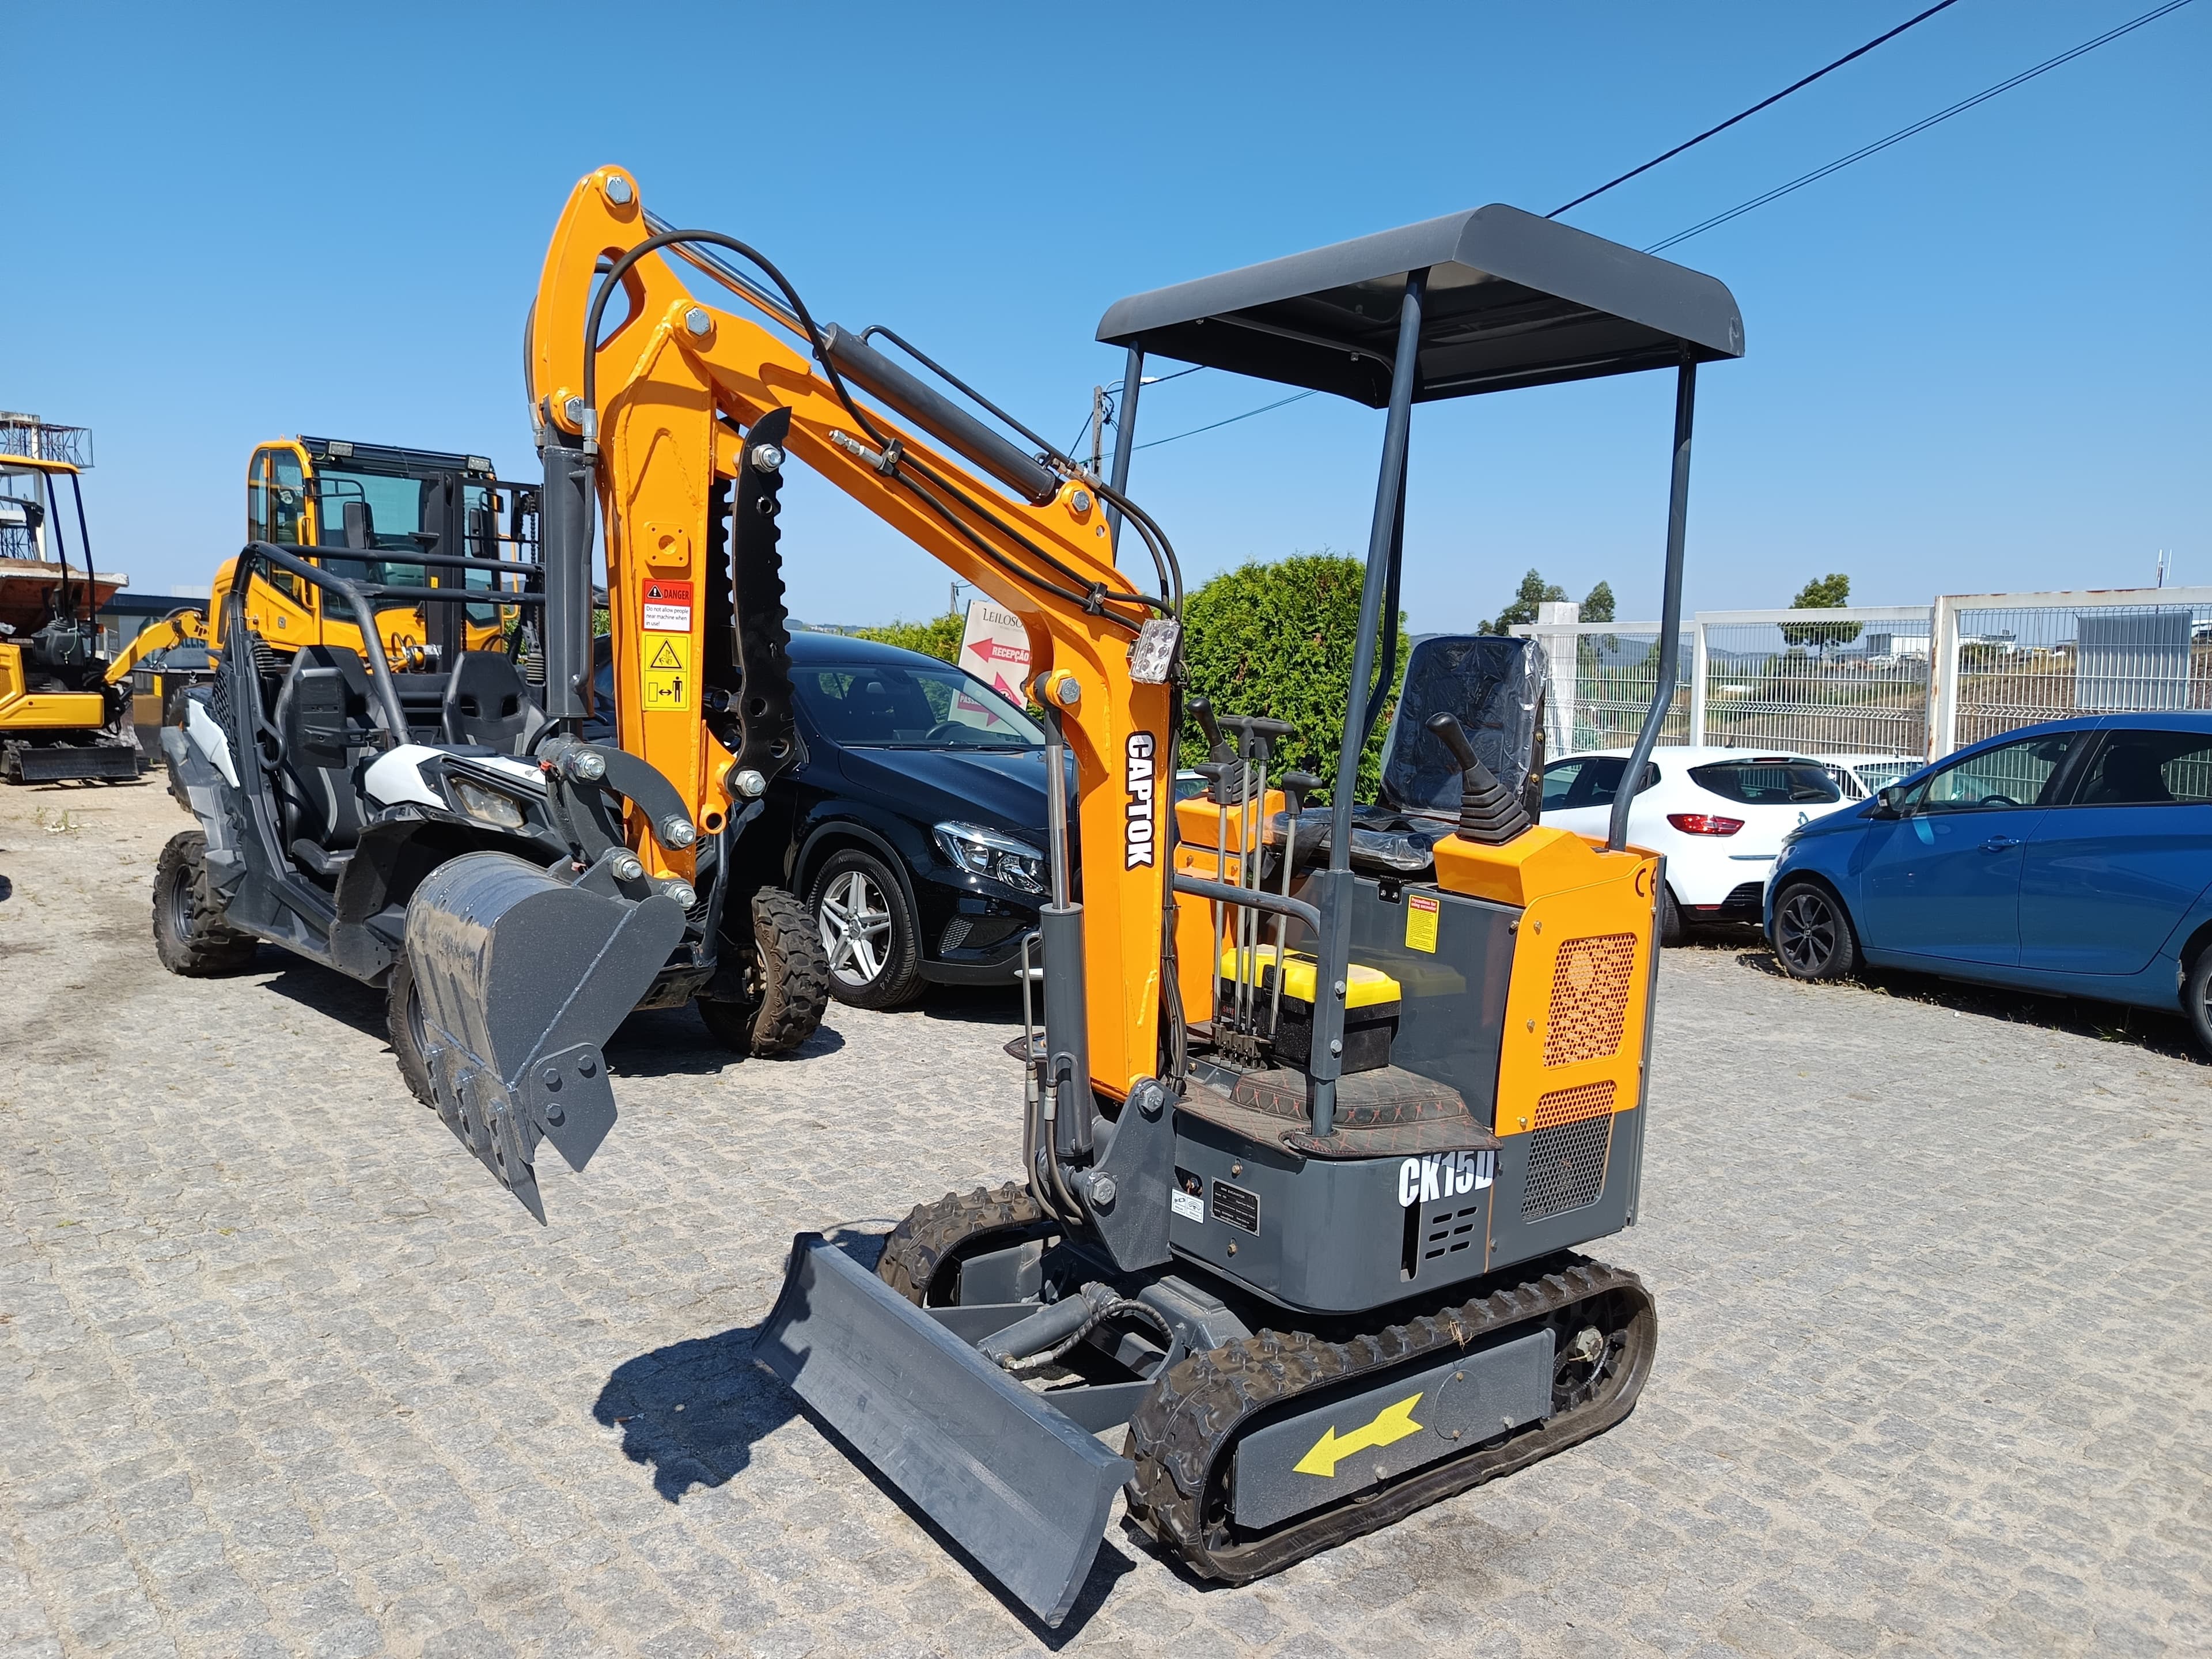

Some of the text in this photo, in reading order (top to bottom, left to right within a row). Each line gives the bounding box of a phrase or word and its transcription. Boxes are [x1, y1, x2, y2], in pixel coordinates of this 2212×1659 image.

[664, 589, 690, 600] DANGER
[992, 646, 1029, 662] RECEPÇÃO
[1127, 733, 1153, 868] CAPTOK
